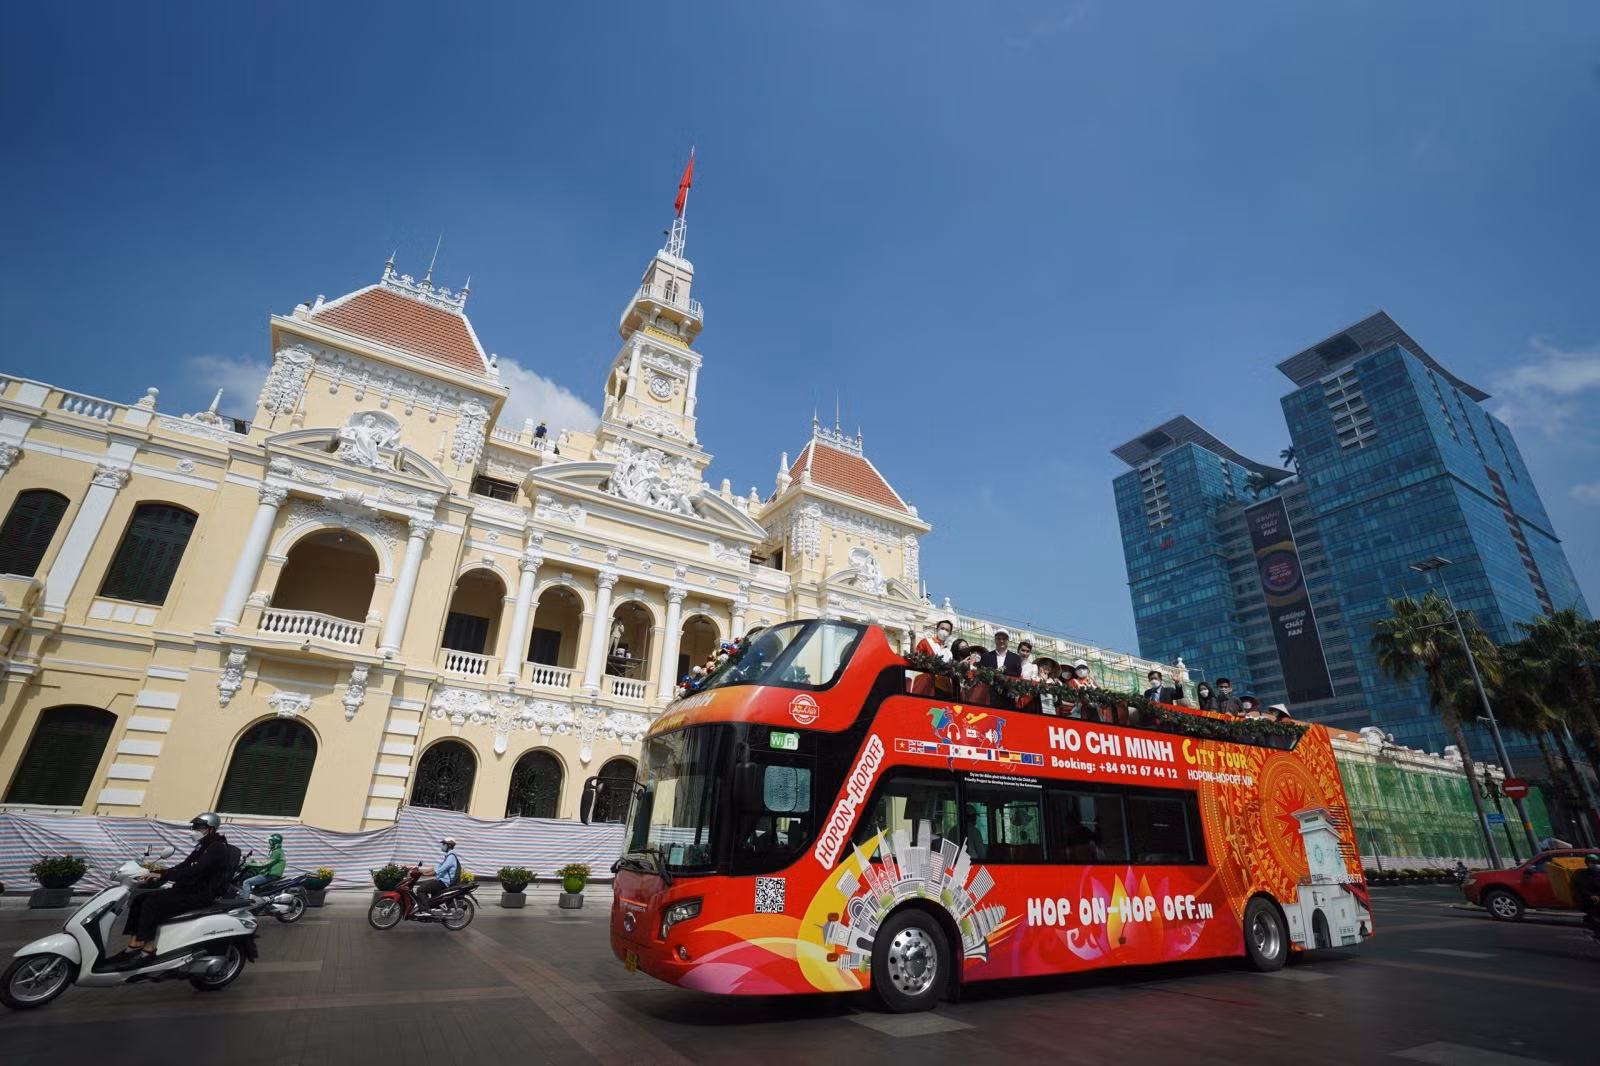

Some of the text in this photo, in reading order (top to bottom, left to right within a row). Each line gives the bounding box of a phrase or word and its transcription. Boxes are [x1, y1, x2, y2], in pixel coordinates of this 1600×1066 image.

[1048, 726, 1175, 763] HO CHI MINH
[1051, 756, 1178, 779] Booking: +84 913 67 44 12
[1217, 751, 1248, 769] TOUR
[819, 803, 852, 865] HOPON
[850, 738, 882, 799] HOPOFF
[1028, 898, 1072, 926] HOP
